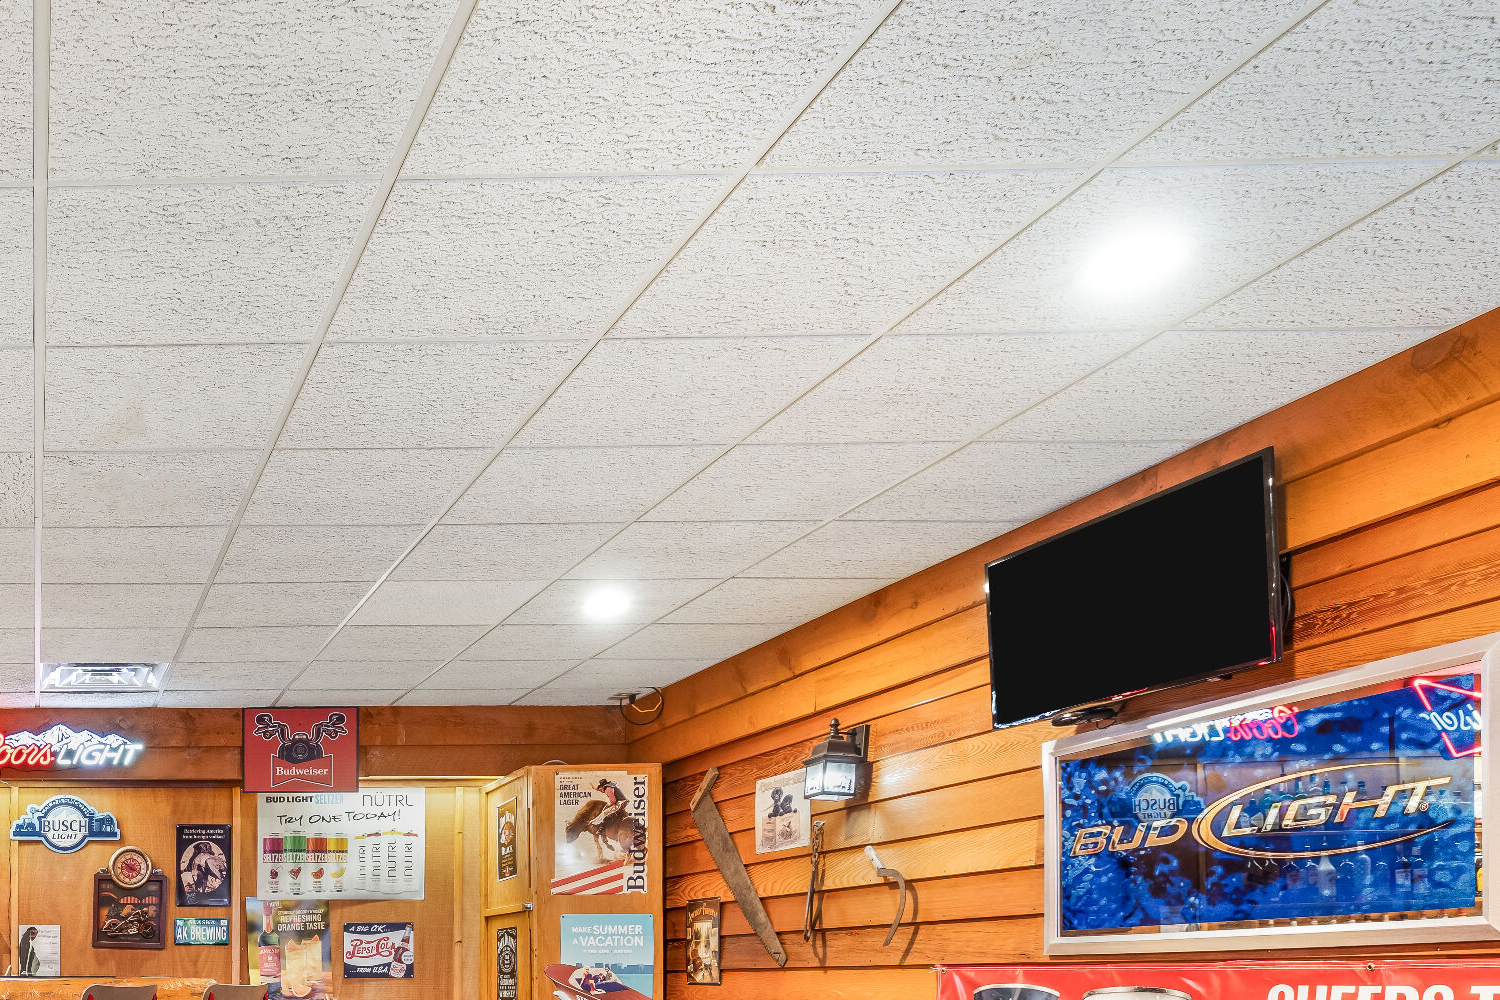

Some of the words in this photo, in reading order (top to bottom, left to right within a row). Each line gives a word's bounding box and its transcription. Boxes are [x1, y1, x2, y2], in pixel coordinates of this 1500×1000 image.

[56, 739, 144, 767] LIGHT
[275, 766, 329, 776] Budweiser
[265, 796, 286, 804] BUD
[315, 793, 344, 805] SELTZER
[559, 791, 592, 799] AMERICAN
[277, 814, 304, 826] TRY
[308, 814, 342, 824] ONE
[344, 810, 402, 822] TODAY!
[1069, 817, 1187, 857] BUD
[1220, 776, 1453, 839] LIGHT
[42, 819, 88, 833] BUSCH
[626, 776, 647, 891] Budweiser
[280, 914, 322, 923] REFRESHING
[176, 925, 189, 941] AK
[190, 925, 227, 941] BREWING
[277, 923, 305, 932] ORANGE
[305, 922, 326, 930] TASTE
[592, 924, 643, 935] SUMMER
[579, 936, 644, 947] VACATION
